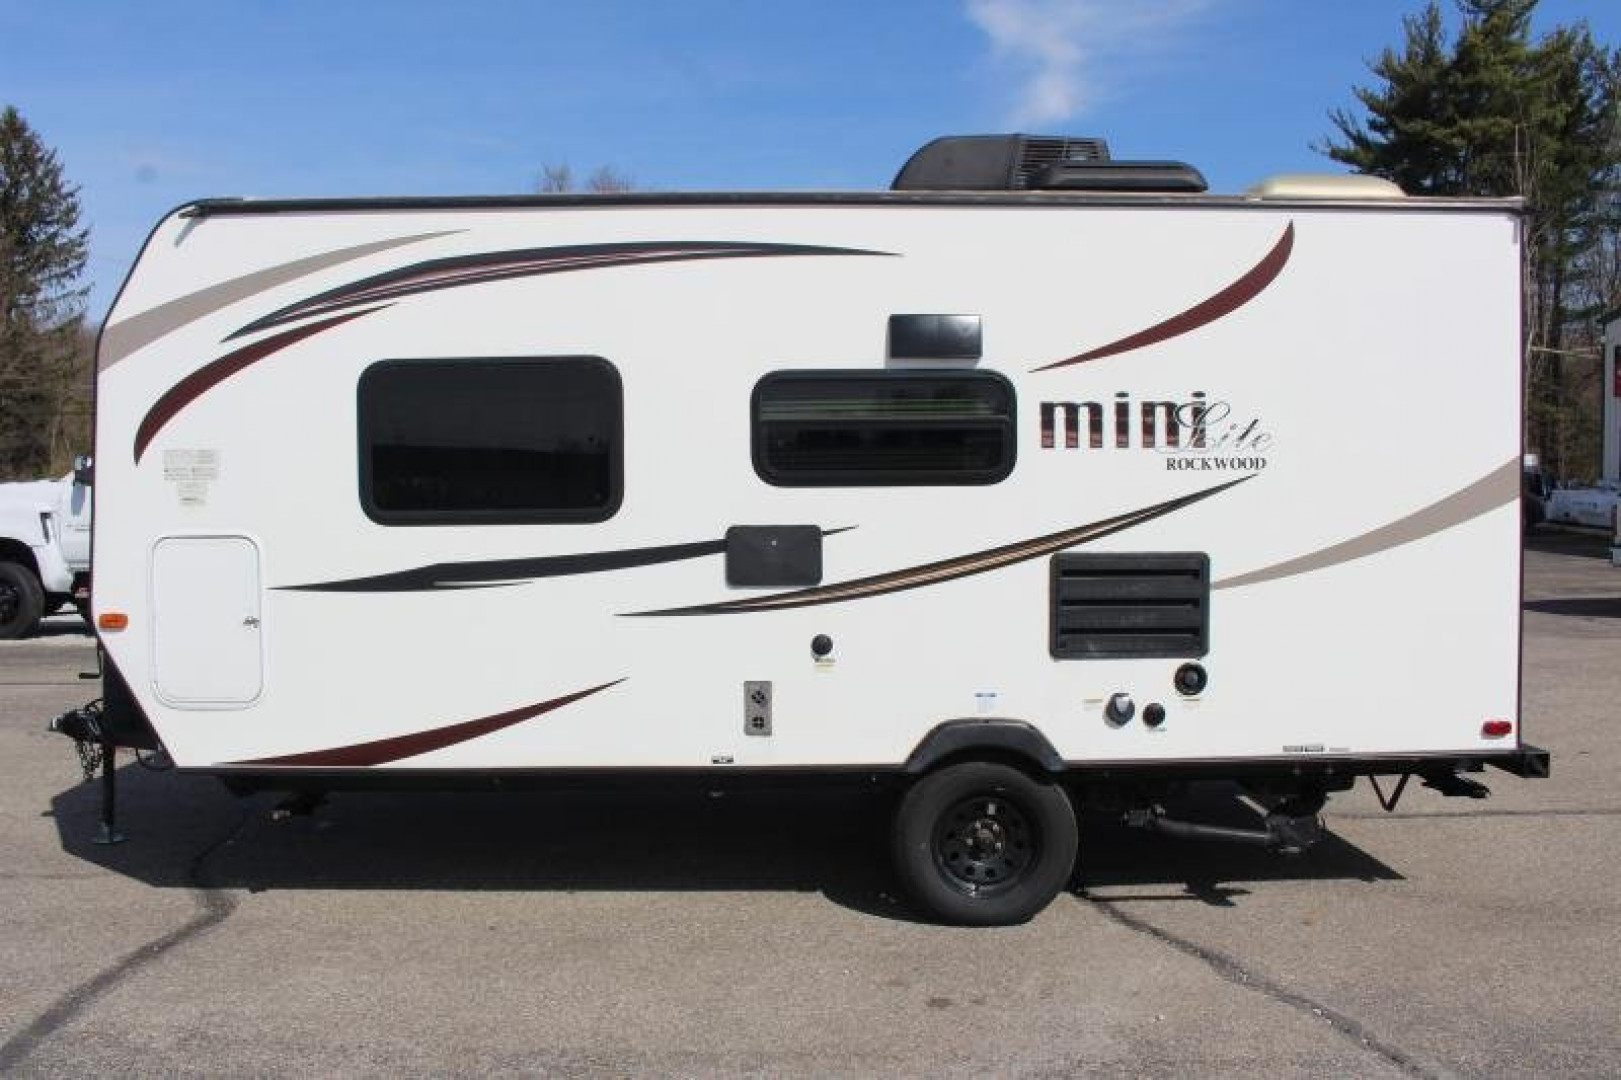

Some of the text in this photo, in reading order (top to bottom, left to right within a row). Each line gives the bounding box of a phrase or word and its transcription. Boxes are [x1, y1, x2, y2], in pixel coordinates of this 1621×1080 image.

[1040, 391, 1271, 454] mini Lite
[1166, 457, 1267, 471] ROCKWOOD
